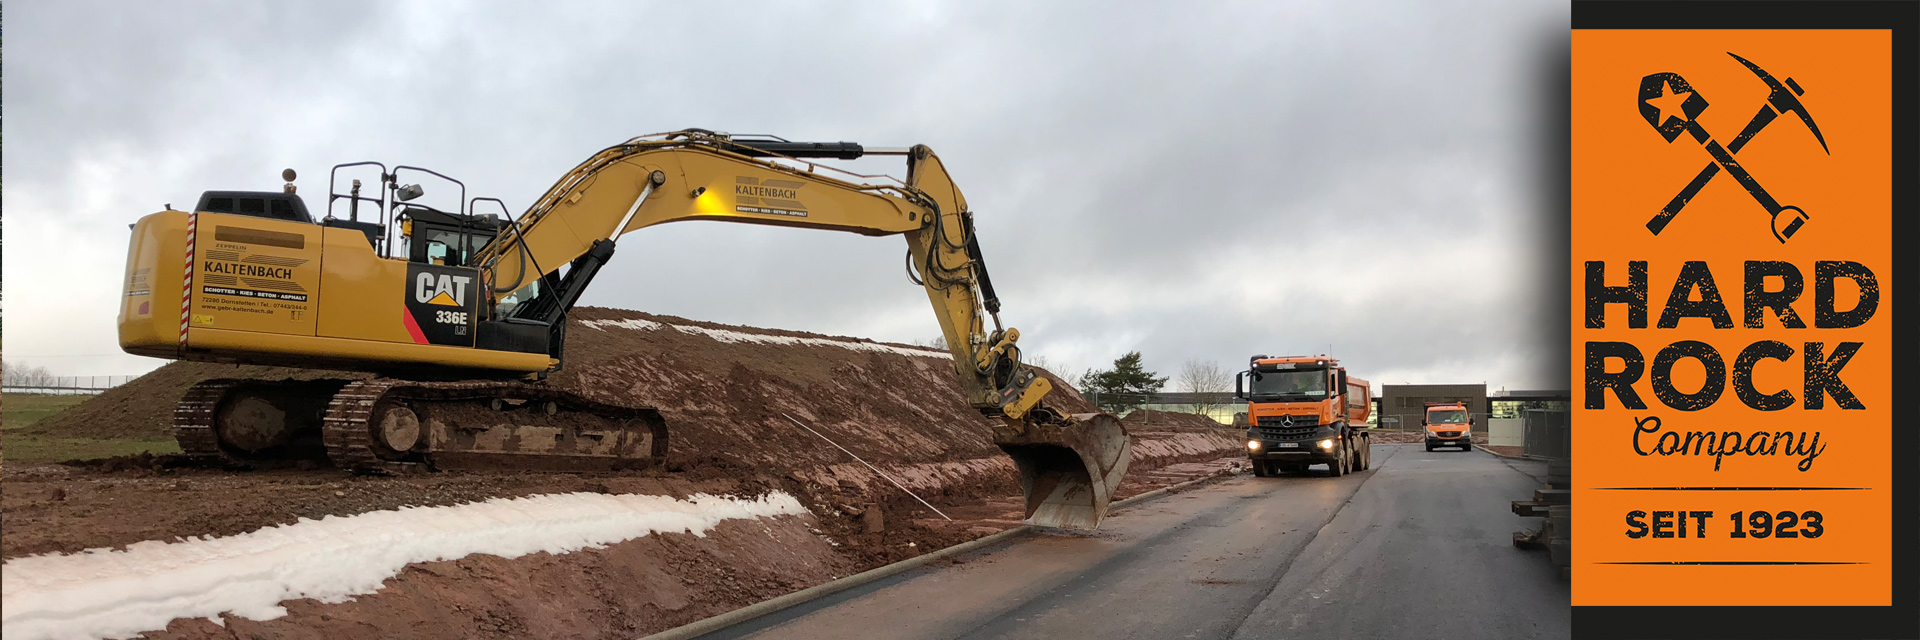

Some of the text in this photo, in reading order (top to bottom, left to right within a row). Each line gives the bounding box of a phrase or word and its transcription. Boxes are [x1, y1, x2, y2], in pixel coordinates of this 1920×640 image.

[735, 185, 796, 199] KALTENBACH
[204, 261, 292, 279] KALTENBACH
[204, 287, 236, 295] SCHOTTER
[415, 272, 470, 307] CAT
[436, 310, 468, 325] 336E
[454, 325, 467, 336] LN
